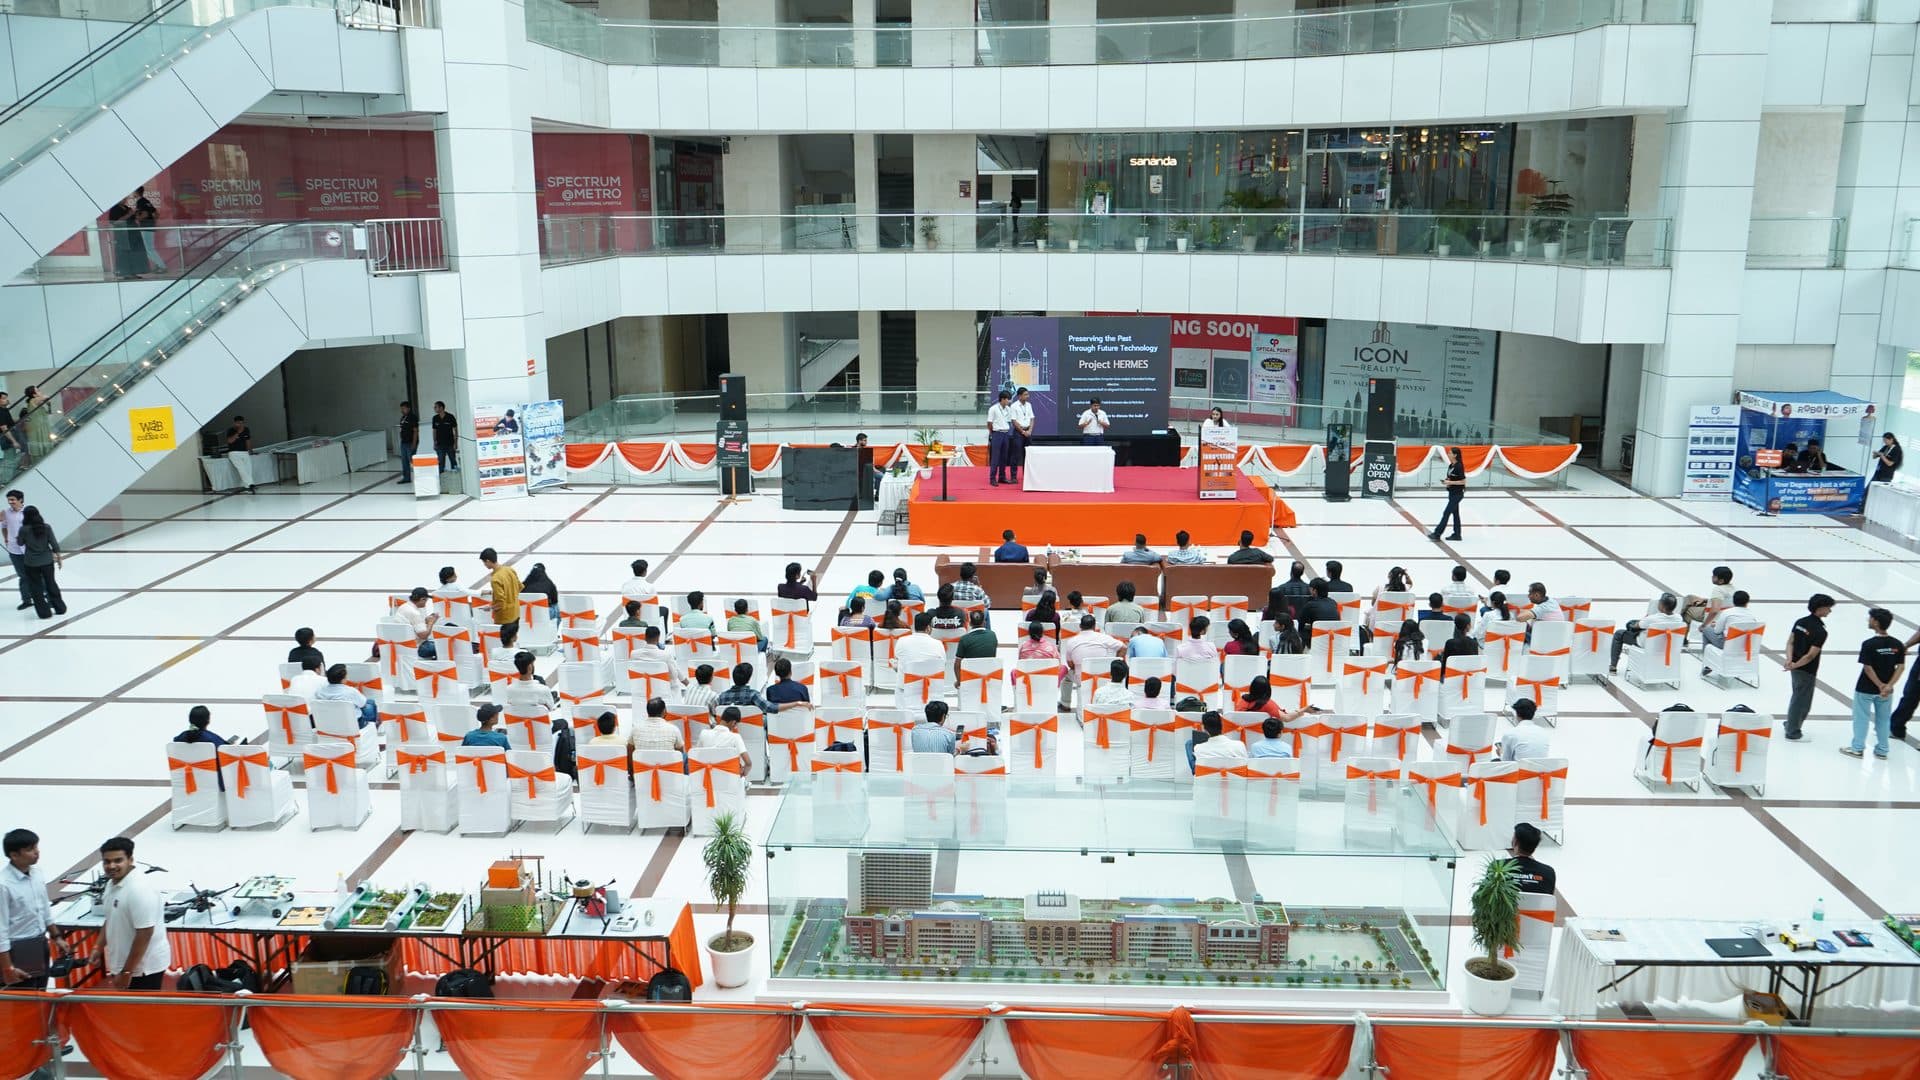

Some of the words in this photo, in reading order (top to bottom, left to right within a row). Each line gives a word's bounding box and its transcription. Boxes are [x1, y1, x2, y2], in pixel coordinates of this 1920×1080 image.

[1129, 155, 1178, 166] sananda
[201, 179, 262, 193] SPECTRUM
[305, 178, 378, 191] SPECTRUM
[547, 176, 622, 188] SPECTRUM
[320, 191, 379, 206] @METRO
[561, 188, 622, 201] @METRO
[214, 193, 263, 209] @METRO
[1207, 320, 1259, 338] SOON
[1068, 335, 1104, 344] Preserving
[1068, 344, 1096, 353] Through
[1120, 344, 1158, 353] Technology
[1354, 346, 1409, 365] ICON
[1078, 359, 1111, 371] Project
[1113, 359, 1149, 369] HERMES
[1360, 364, 1401, 374] REALITY
[1797, 403, 1838, 417] ROBOTIC
[1842, 406, 1857, 414] SIR
[1369, 462, 1392, 471] NOW
[1367, 470, 1391, 479] OPEN
[1789, 481, 1812, 489] Degree
